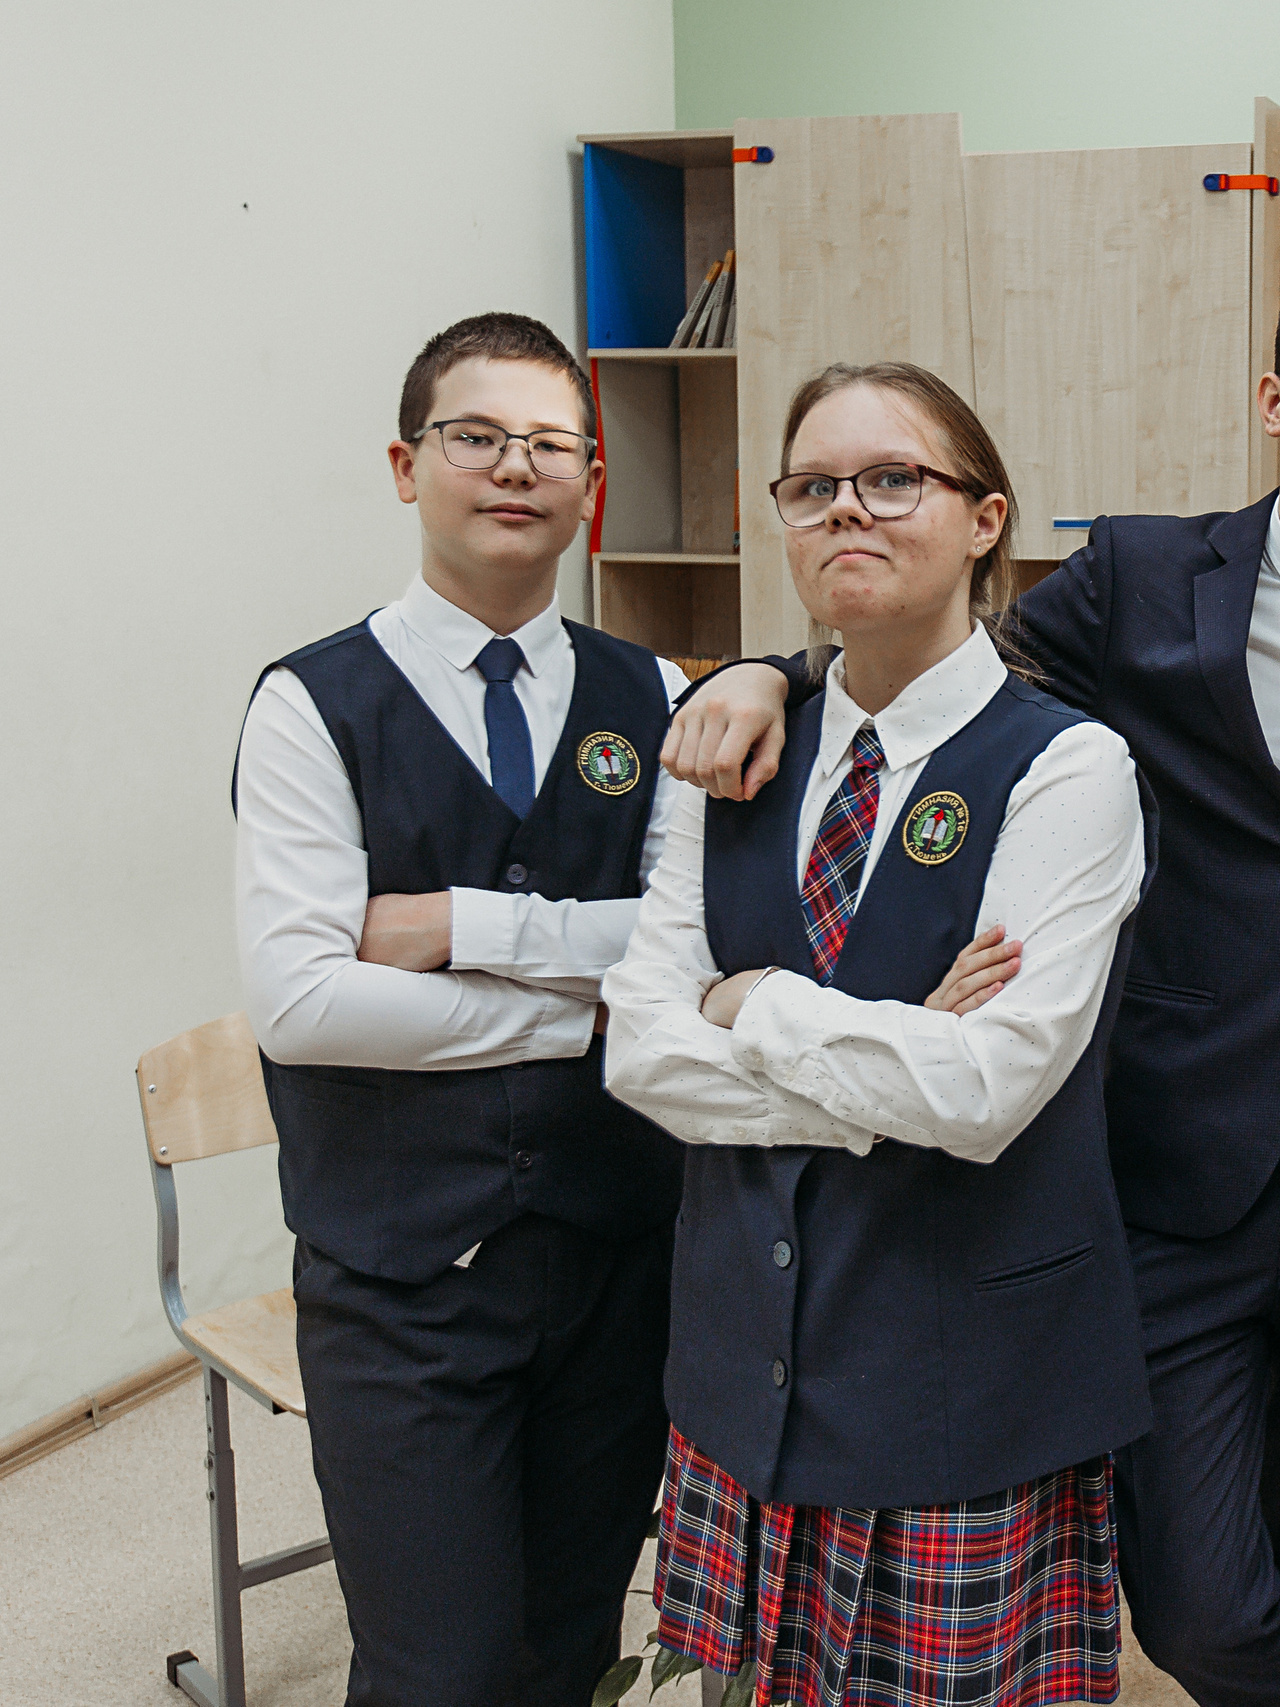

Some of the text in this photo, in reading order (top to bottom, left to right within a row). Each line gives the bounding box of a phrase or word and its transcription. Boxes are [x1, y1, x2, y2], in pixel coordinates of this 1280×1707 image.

[580, 735, 615, 765] ГИМНАЗИЯ
[603, 778, 634, 791] Тюмень
[912, 795, 959, 820] ГИМНАЗИЯ
